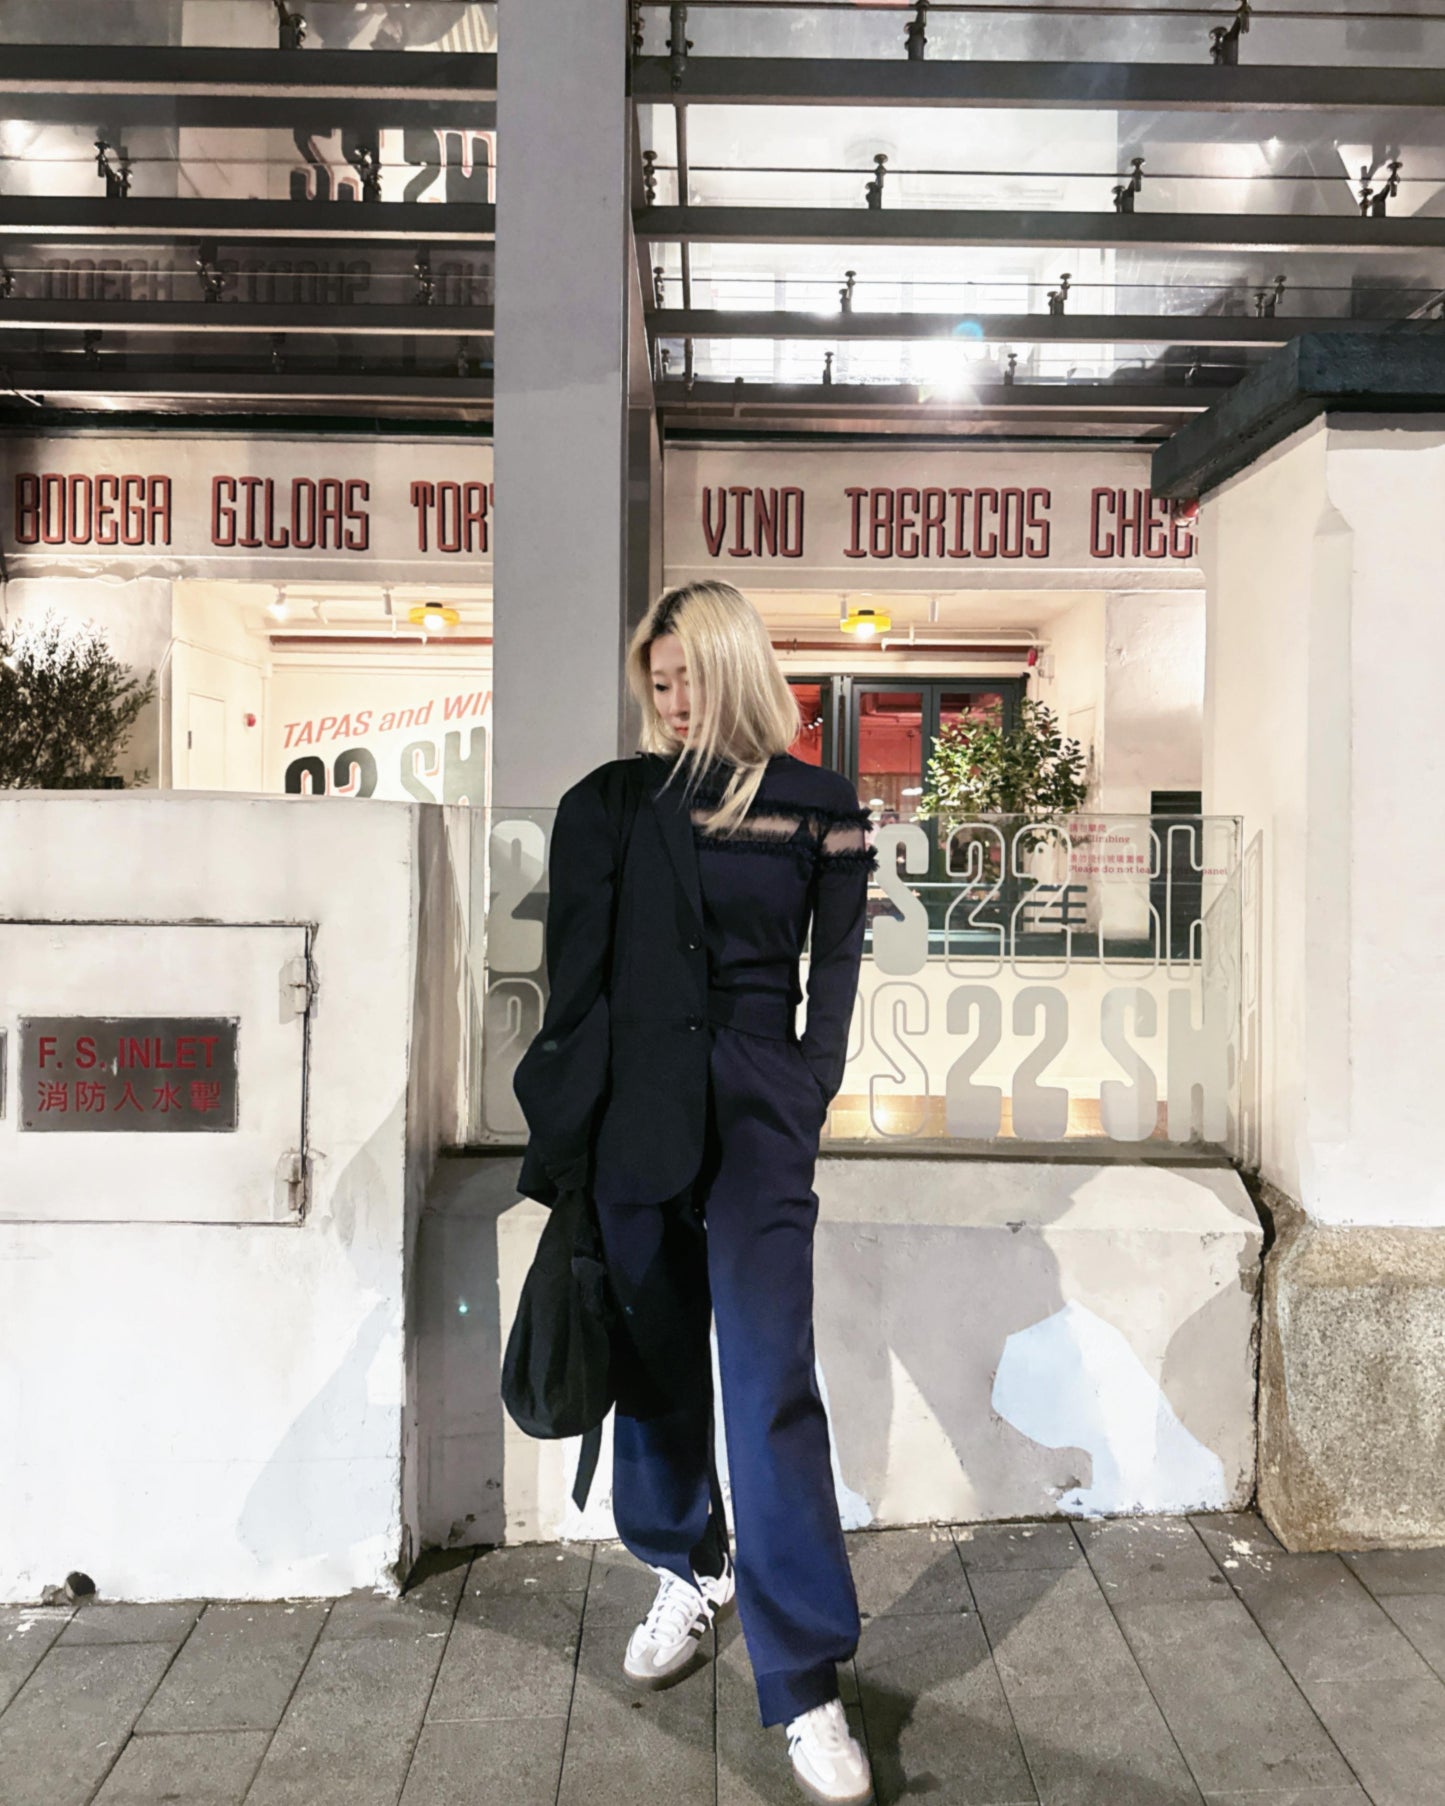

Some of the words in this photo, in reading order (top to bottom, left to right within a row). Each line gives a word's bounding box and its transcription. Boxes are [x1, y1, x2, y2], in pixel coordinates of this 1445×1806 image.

[14, 473, 172, 546] BODEGA
[211, 475, 370, 551] GILDAS
[410, 480, 494, 553] TOR
[702, 486, 804, 558] VINO
[843, 486, 1051, 558] IBERICOS
[1090, 486, 1199, 558] CHEE
[284, 710, 373, 749] TAPAS
[378, 700, 434, 732] and
[945, 823, 1072, 979] 22
[1070, 865, 1099, 874] Please
[1103, 865, 1117, 874] do
[1118, 866, 1134, 875] not
[38, 1037, 63, 1068] F.
[75, 1037, 106, 1069] S.
[118, 1036, 220, 1069] INLET
[946, 985, 1070, 1139] 22
